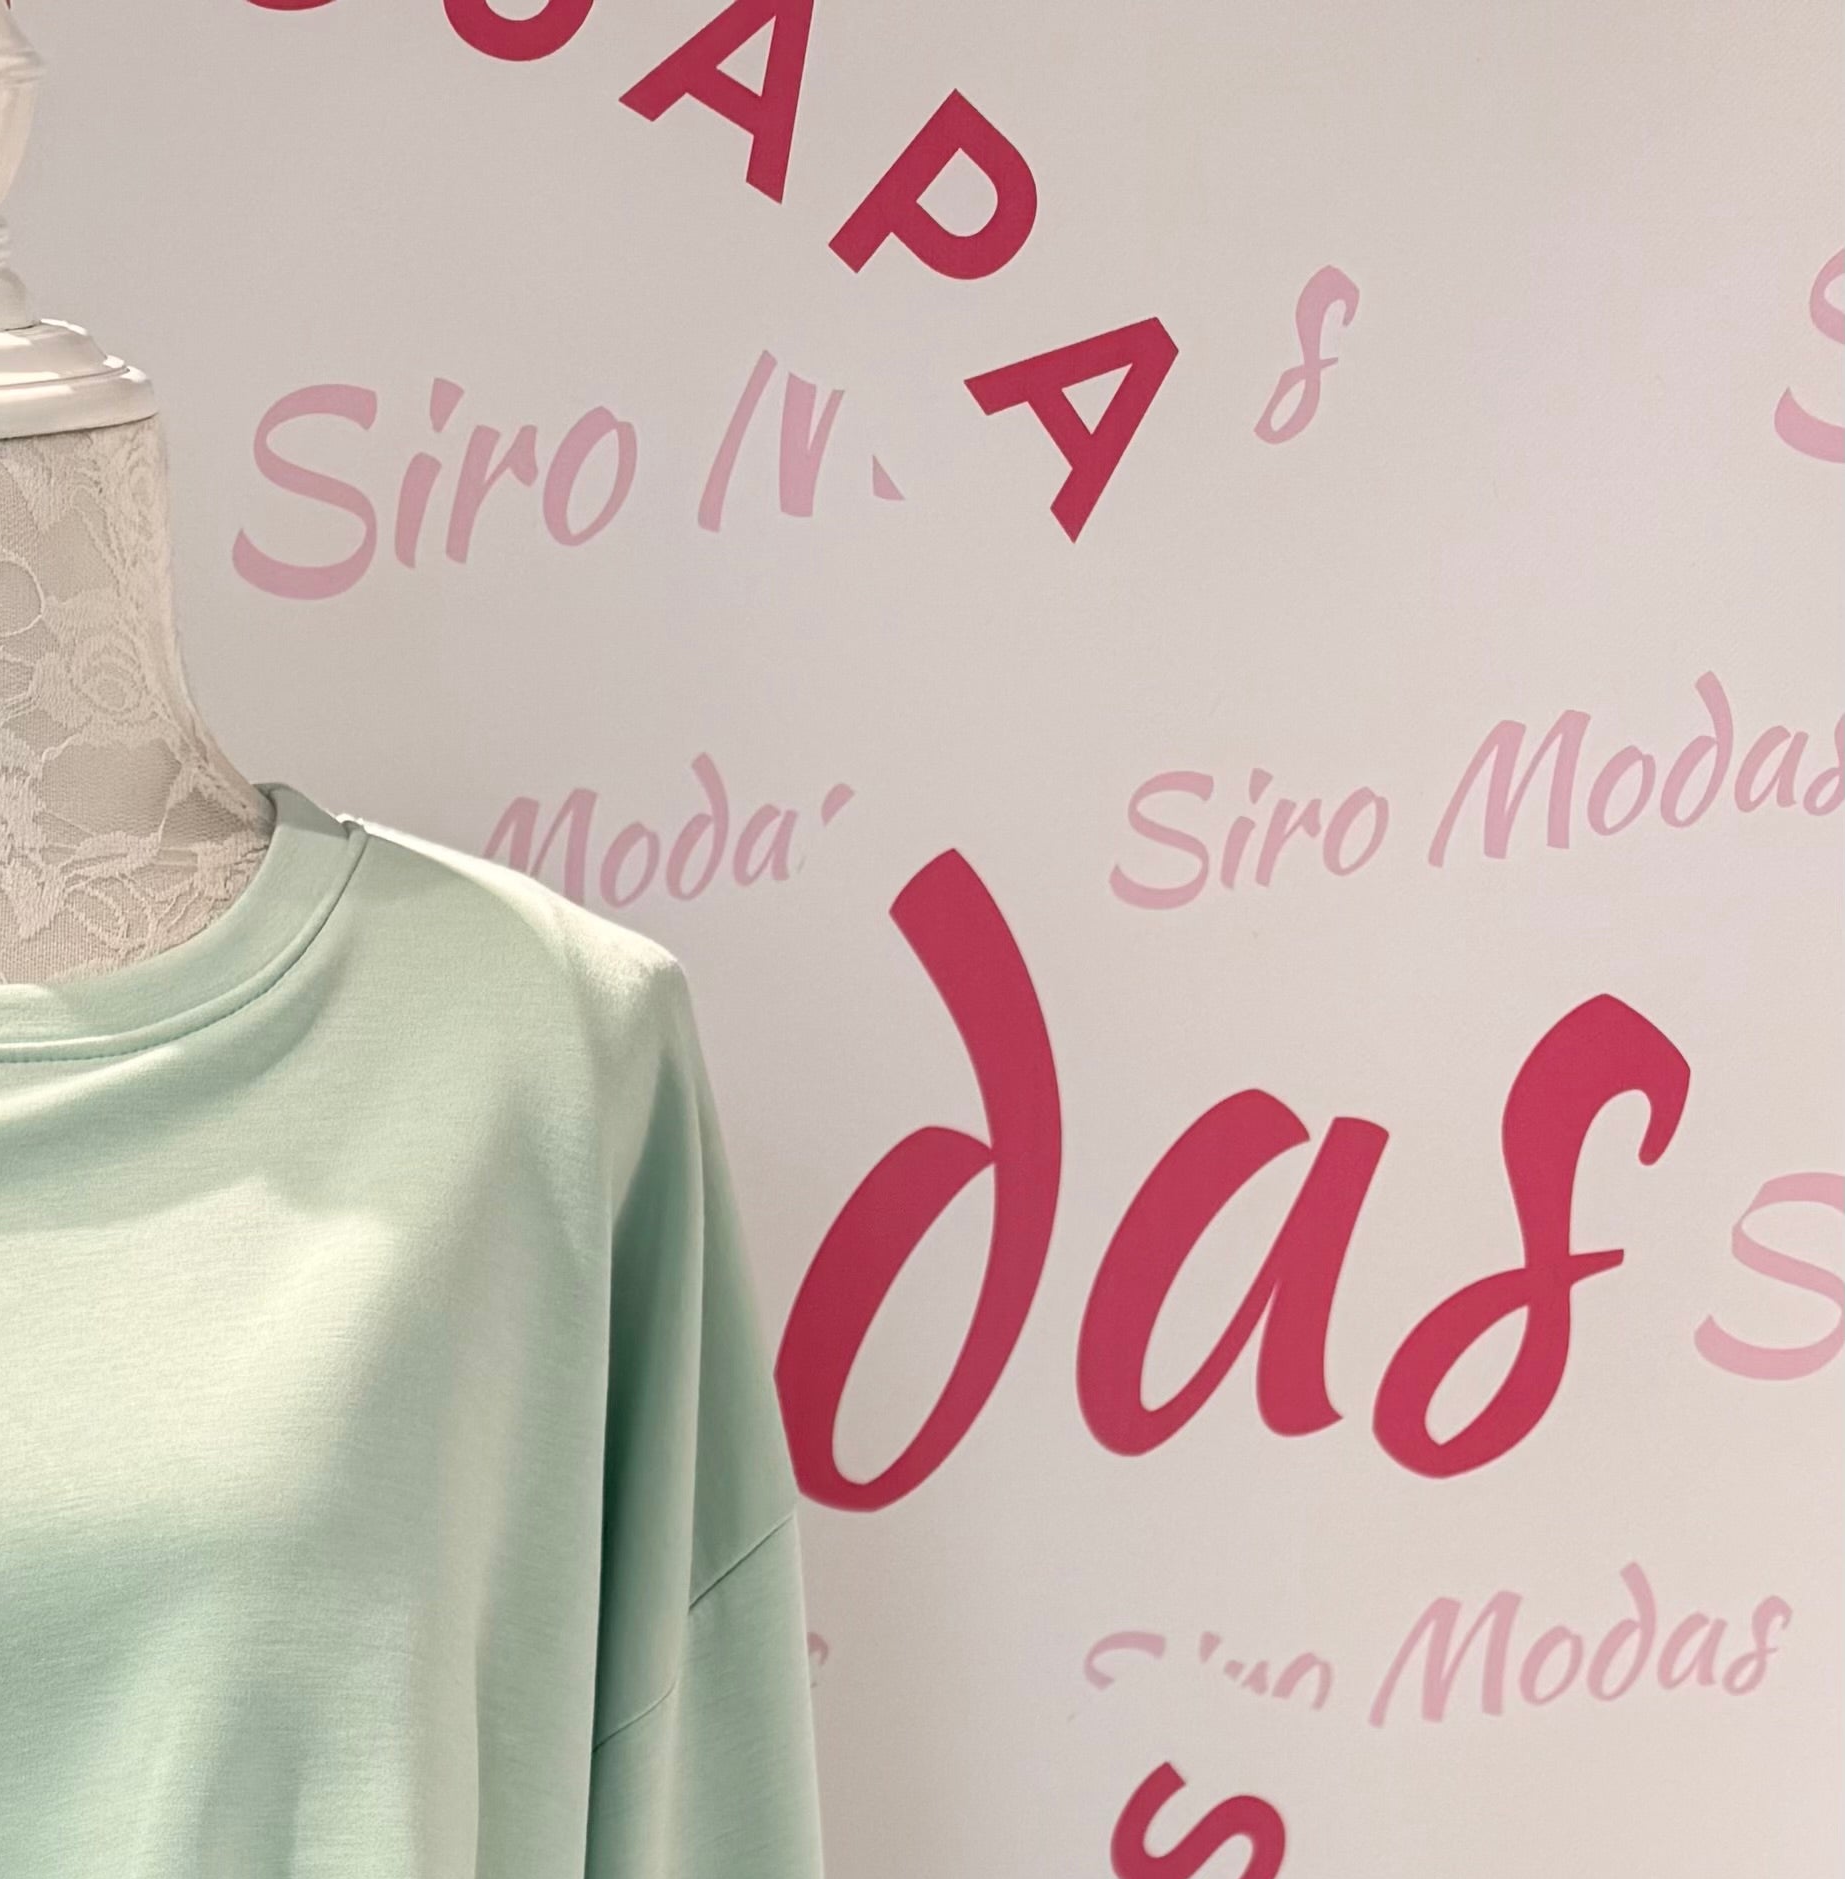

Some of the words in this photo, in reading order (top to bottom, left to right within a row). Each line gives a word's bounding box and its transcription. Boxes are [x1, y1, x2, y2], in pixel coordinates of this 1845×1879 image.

[232, 379, 639, 601] Siro
[1108, 768, 1391, 910] Siro
[774, 848, 1692, 1512] das
[1368, 1561, 1792, 1728] Modas
